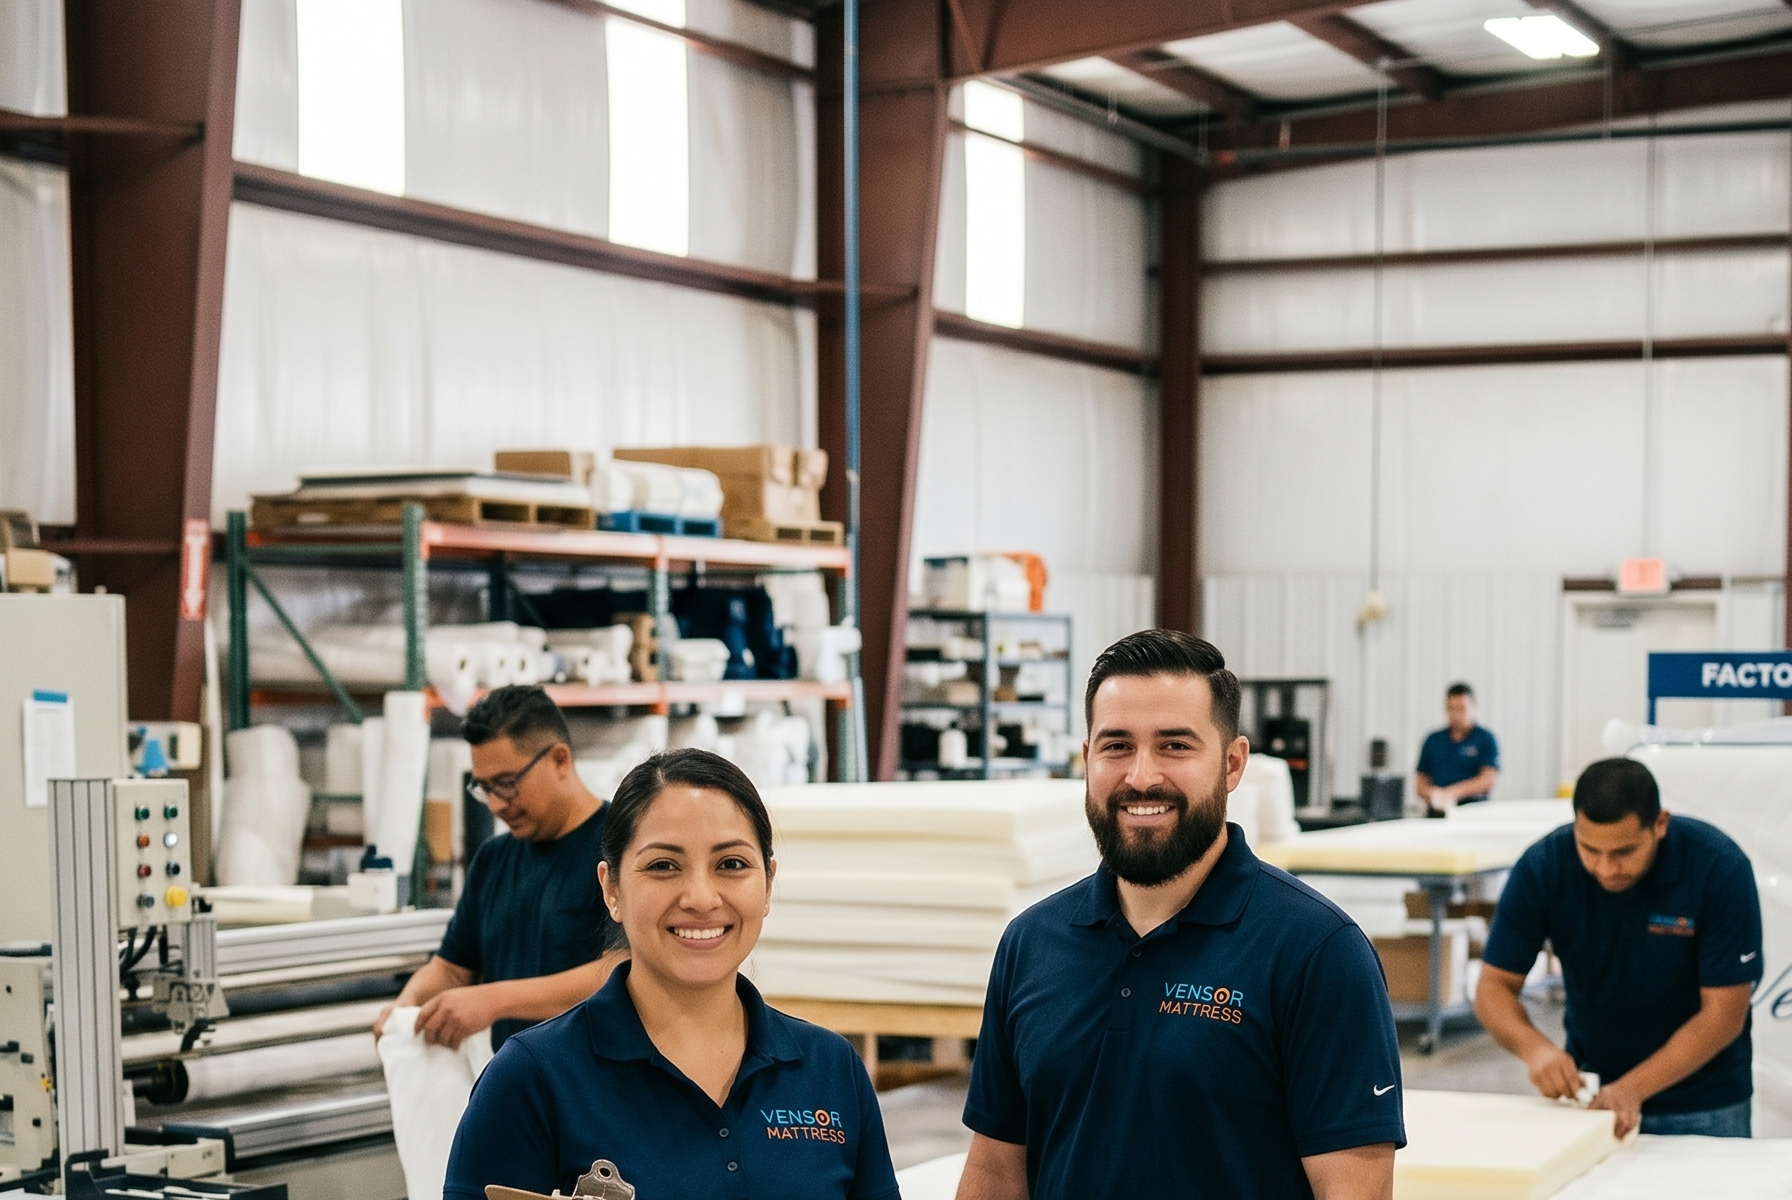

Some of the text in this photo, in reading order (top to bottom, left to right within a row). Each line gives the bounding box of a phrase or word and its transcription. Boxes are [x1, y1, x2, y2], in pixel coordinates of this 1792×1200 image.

[1701, 662, 1792, 688] FACTO
[1165, 982, 1244, 1007] VENSOR
[1159, 1001, 1242, 1024] MATTRESS
[760, 1109, 842, 1128] VENSOR
[767, 1127, 846, 1144] MATTRESS
